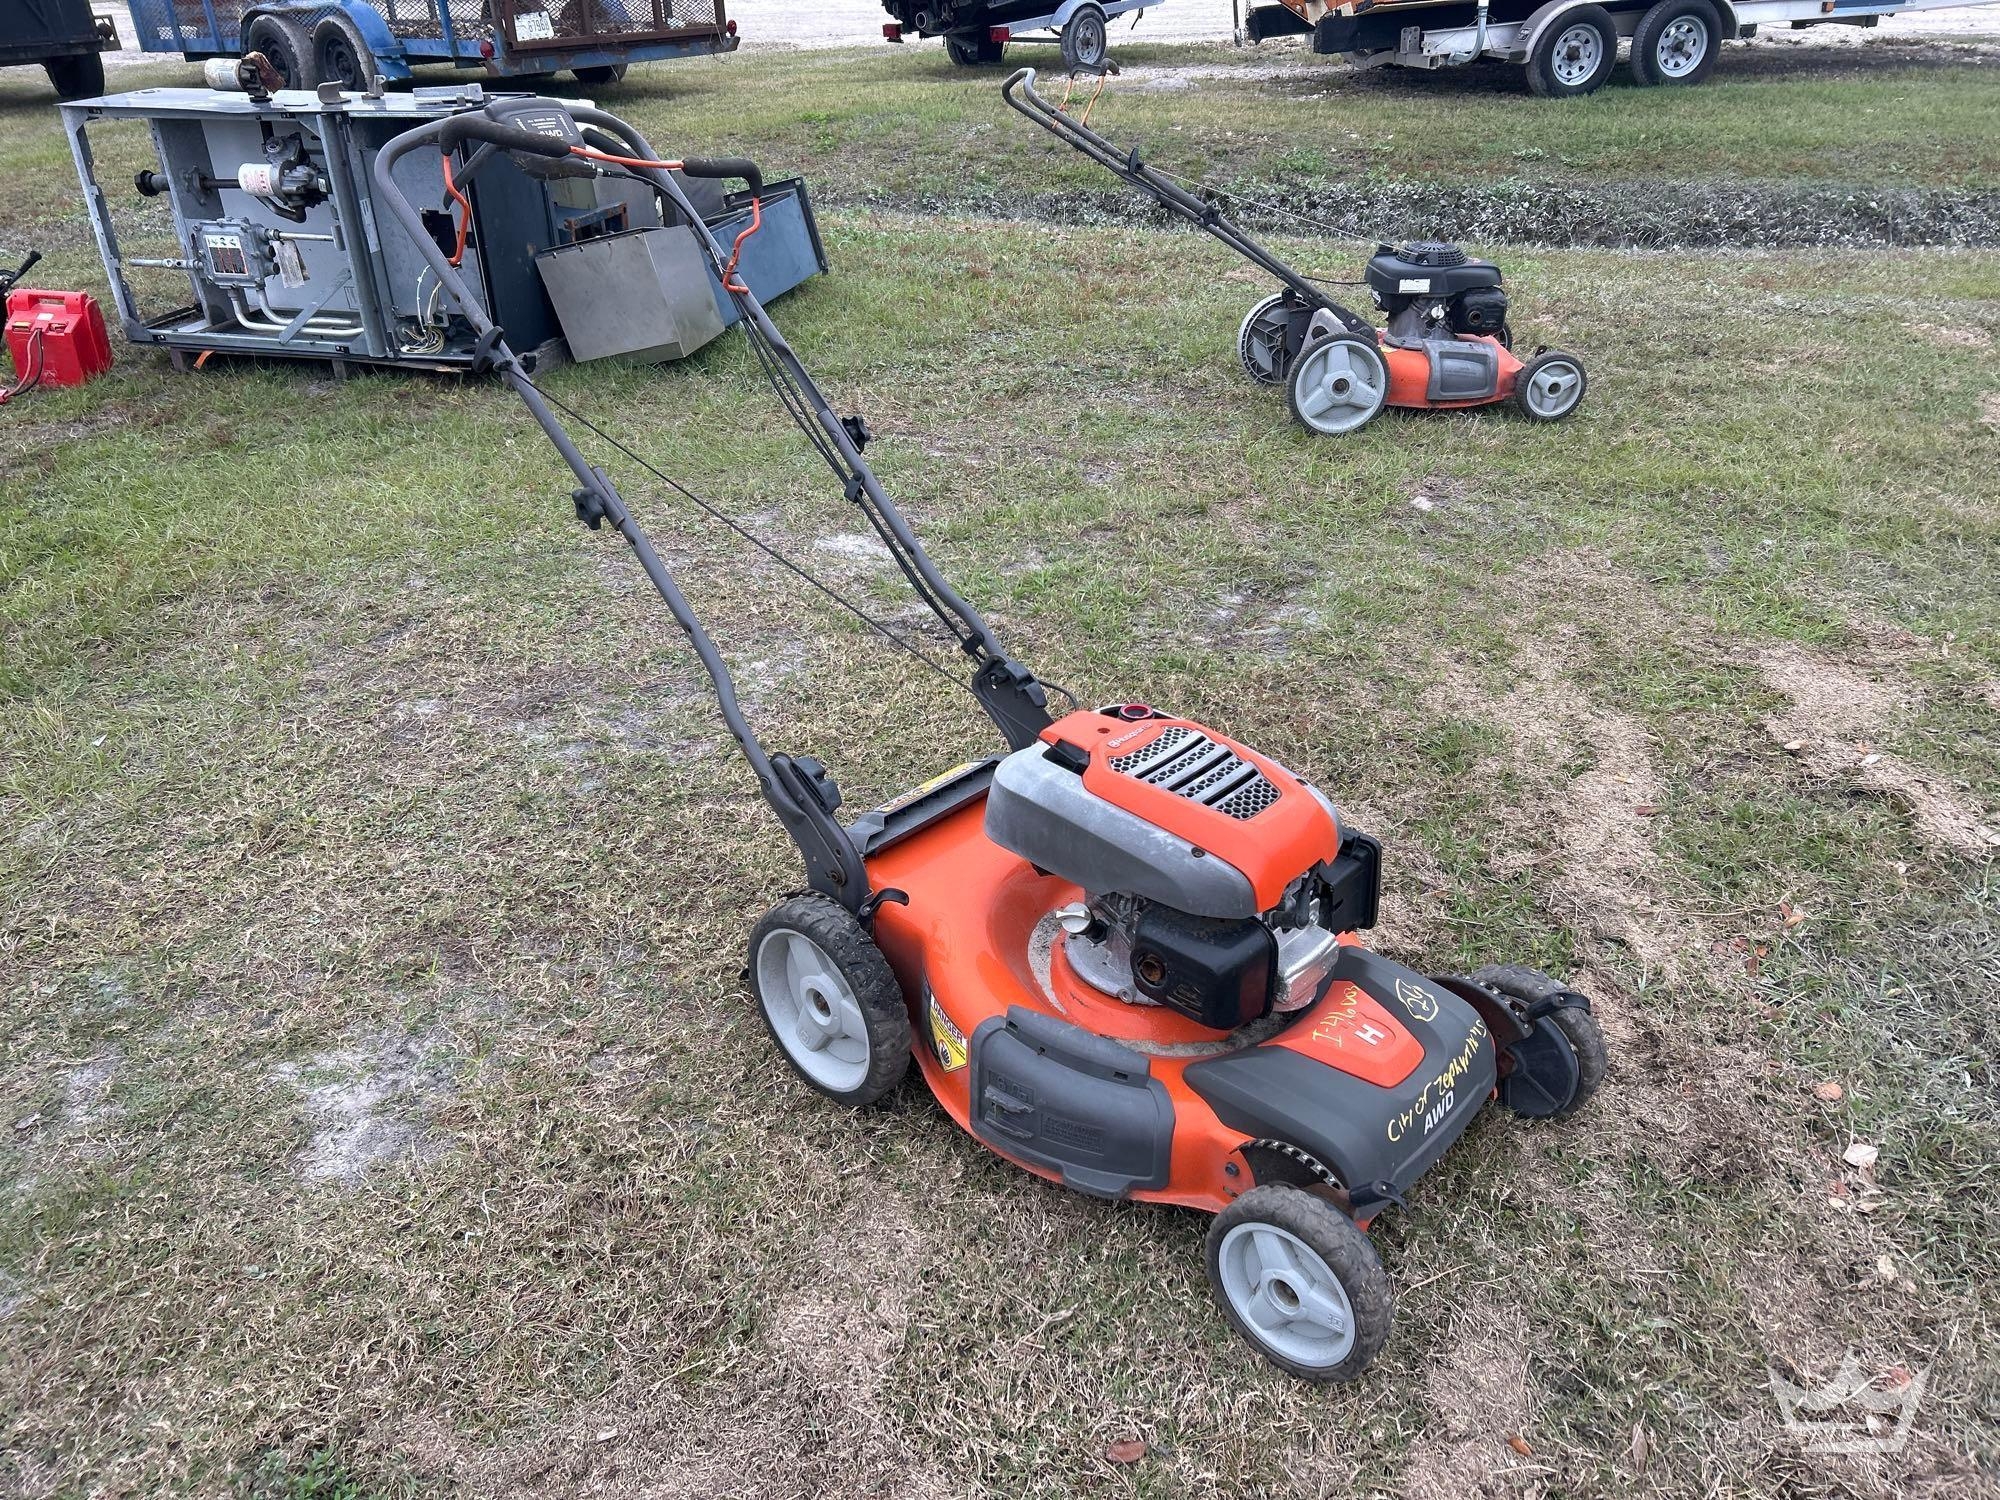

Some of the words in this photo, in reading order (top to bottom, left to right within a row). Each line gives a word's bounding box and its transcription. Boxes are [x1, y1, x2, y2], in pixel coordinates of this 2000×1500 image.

[933, 999, 963, 1045] DANGER
[1354, 1023, 1386, 1046] H
[1423, 1090, 1455, 1136] AWD
